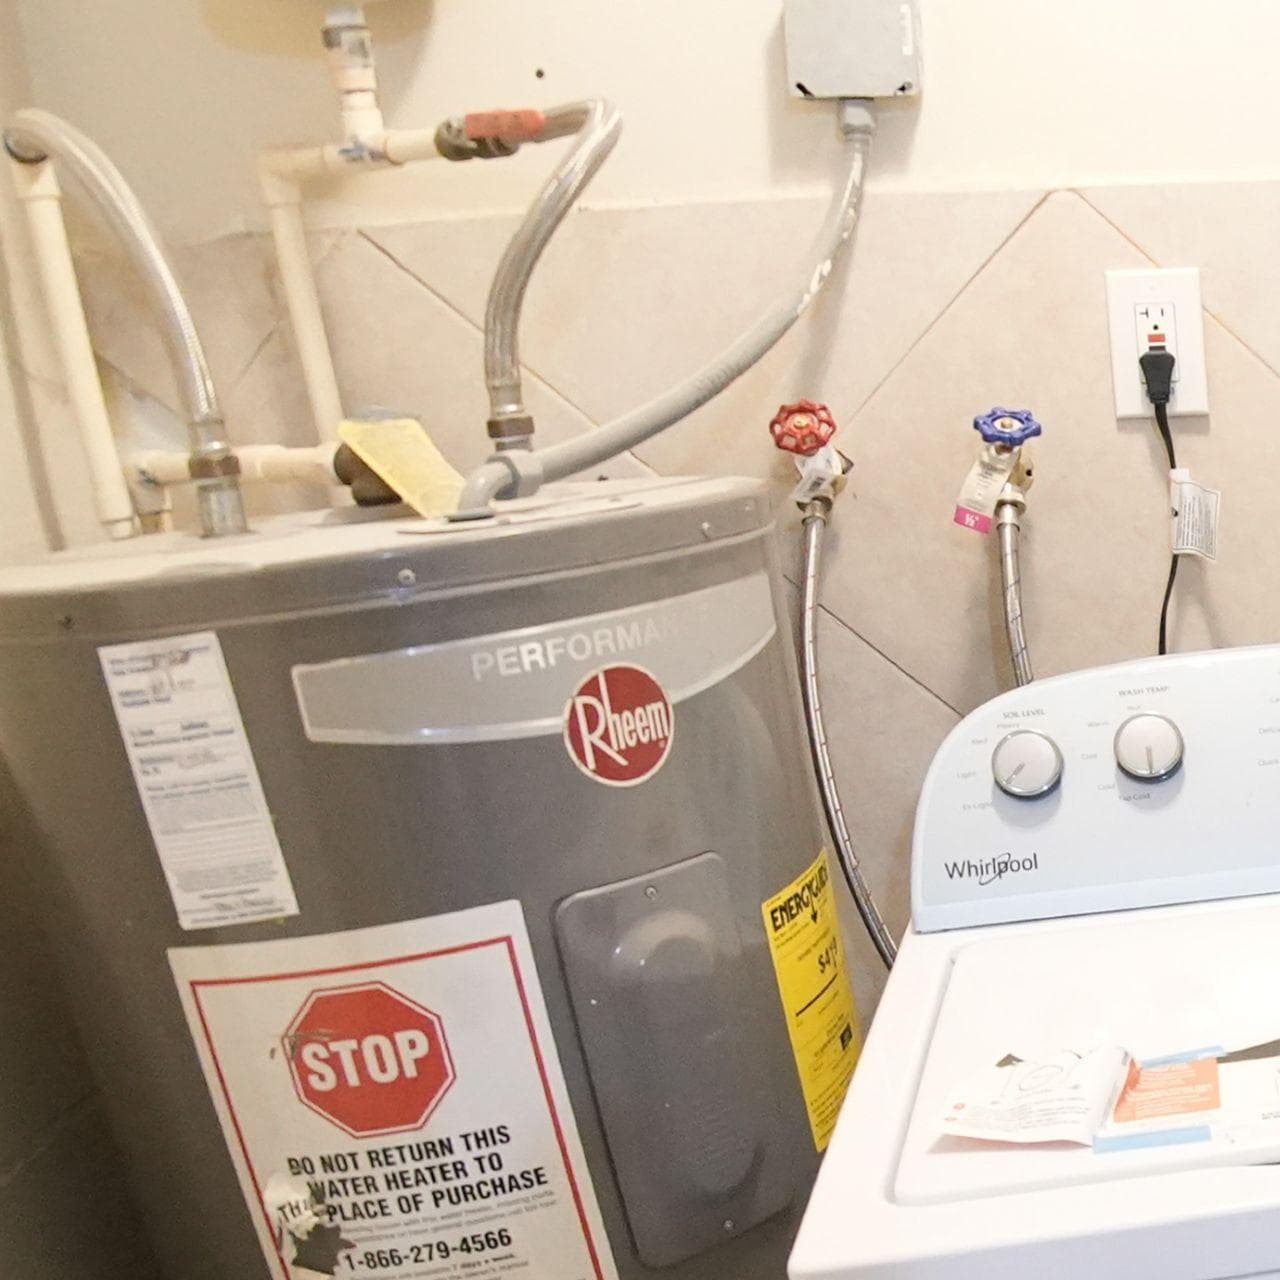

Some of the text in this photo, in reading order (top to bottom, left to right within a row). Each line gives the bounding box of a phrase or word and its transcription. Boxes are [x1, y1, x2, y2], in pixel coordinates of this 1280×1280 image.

[1146, 685, 1170, 694] TEMP
[574, 671, 669, 771] Rheem
[944, 852, 1039, 886] Whirlpool
[301, 1029, 430, 1092] STOP
[286, 1124, 511, 1176] DO NOT RETURN THIS
[306, 1152, 505, 1202] WATER HEATER TO
[325, 1198, 393, 1223] PLACE
[398, 1191, 431, 1216] OF
[432, 1166, 549, 1208] PURCHASE
[343, 1227, 514, 1273] 1-866-279-4566
